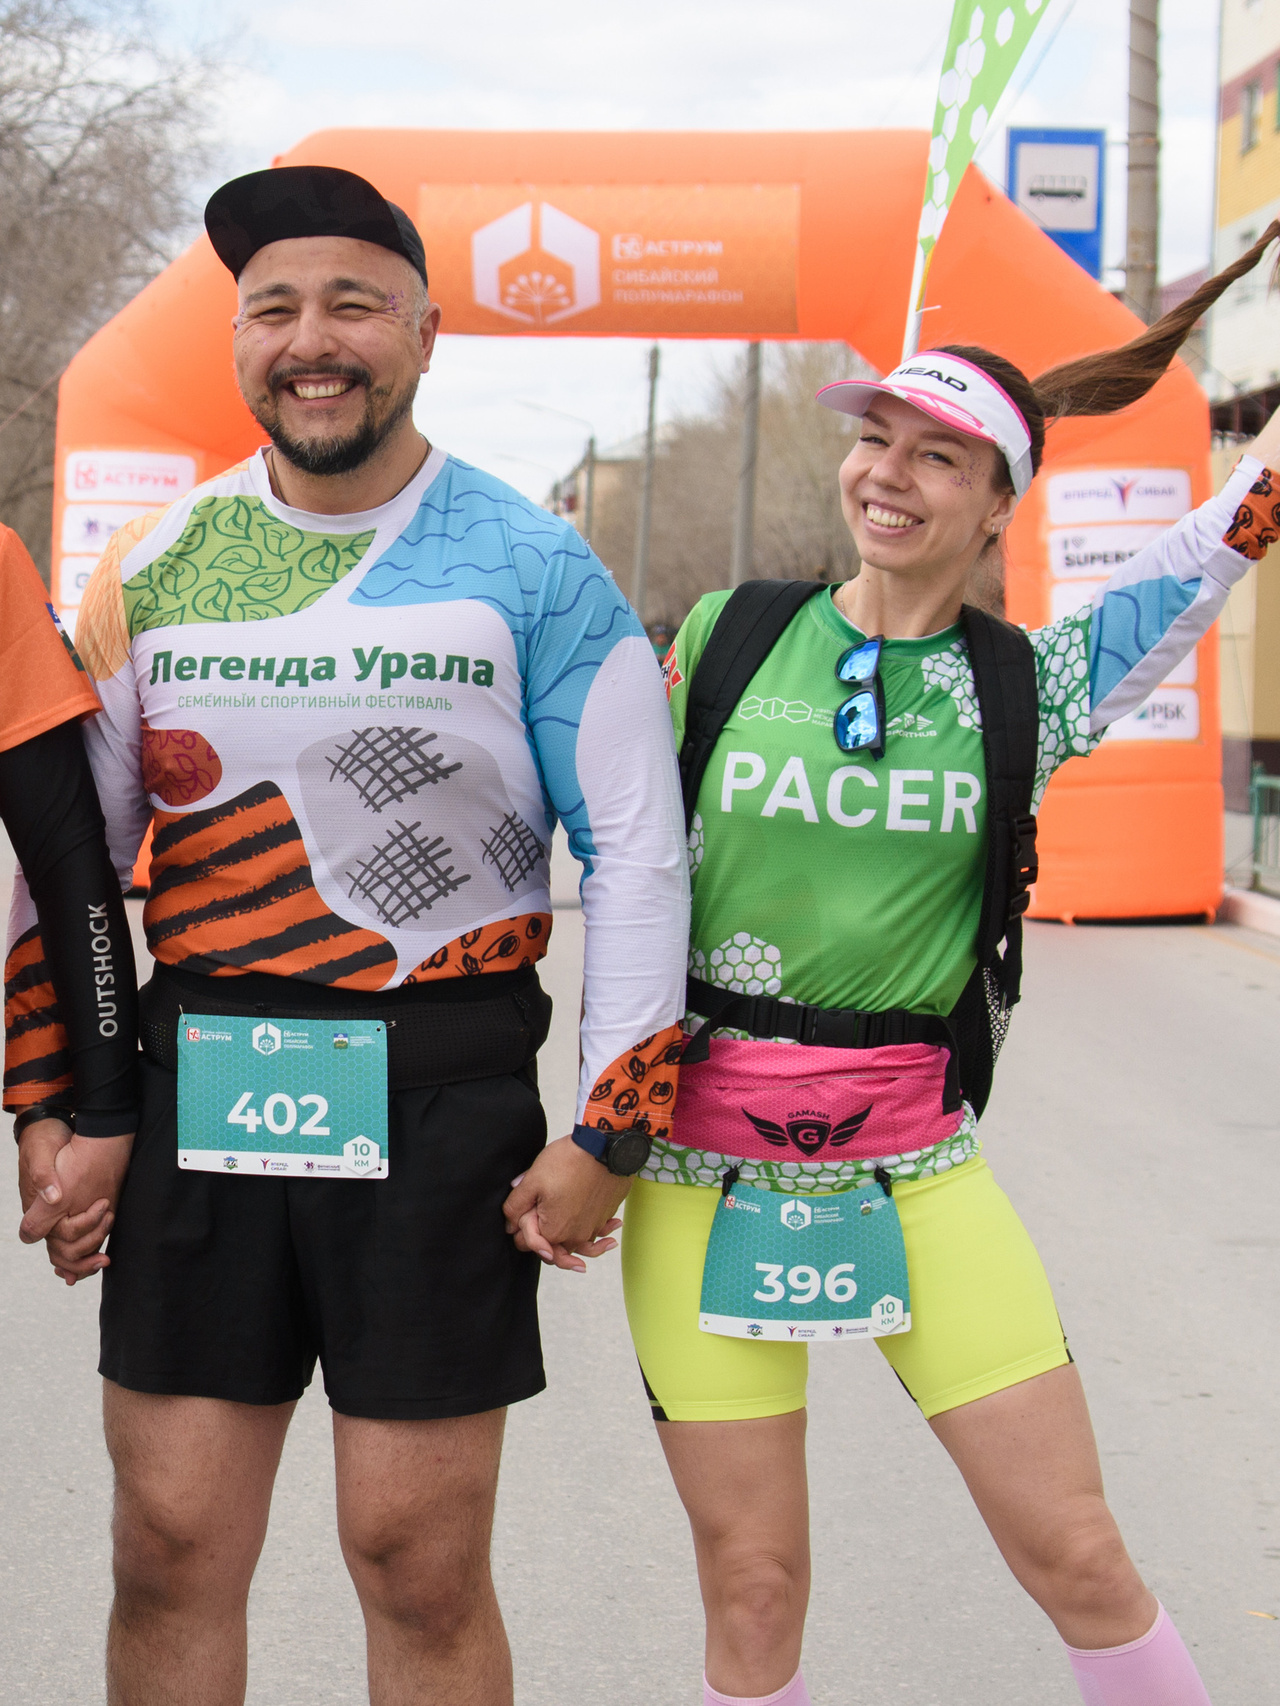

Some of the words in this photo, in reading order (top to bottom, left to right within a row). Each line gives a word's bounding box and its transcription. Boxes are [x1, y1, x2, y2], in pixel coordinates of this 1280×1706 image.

[644, 241, 723, 256] АСТРУМ
[613, 268, 719, 285] СИБАЙСКИЙ
[614, 290, 744, 304] ПОЛУМАРАФОН
[889, 367, 968, 393] HEAD
[103, 473, 178, 487] АСТРУМ
[149, 650, 337, 688] Легенда
[351, 645, 495, 690] Урала
[365, 694, 453, 711] ФЕСТИВАЛЬ
[1151, 703, 1187, 720] РБК
[721, 751, 981, 834] PACER
[88, 902, 118, 1037] OUTSHOCK
[201, 1034, 232, 1042] АСТРУМ
[227, 1092, 330, 1136] 402
[788, 1110, 830, 1120] GAMASH
[798, 1128, 820, 1144] G
[352, 1143, 370, 1156] 10
[735, 1203, 761, 1213] АСТРУМ
[753, 1262, 857, 1304] 396
[879, 1302, 895, 1315] 10
[880, 1317, 894, 1326] КМ
